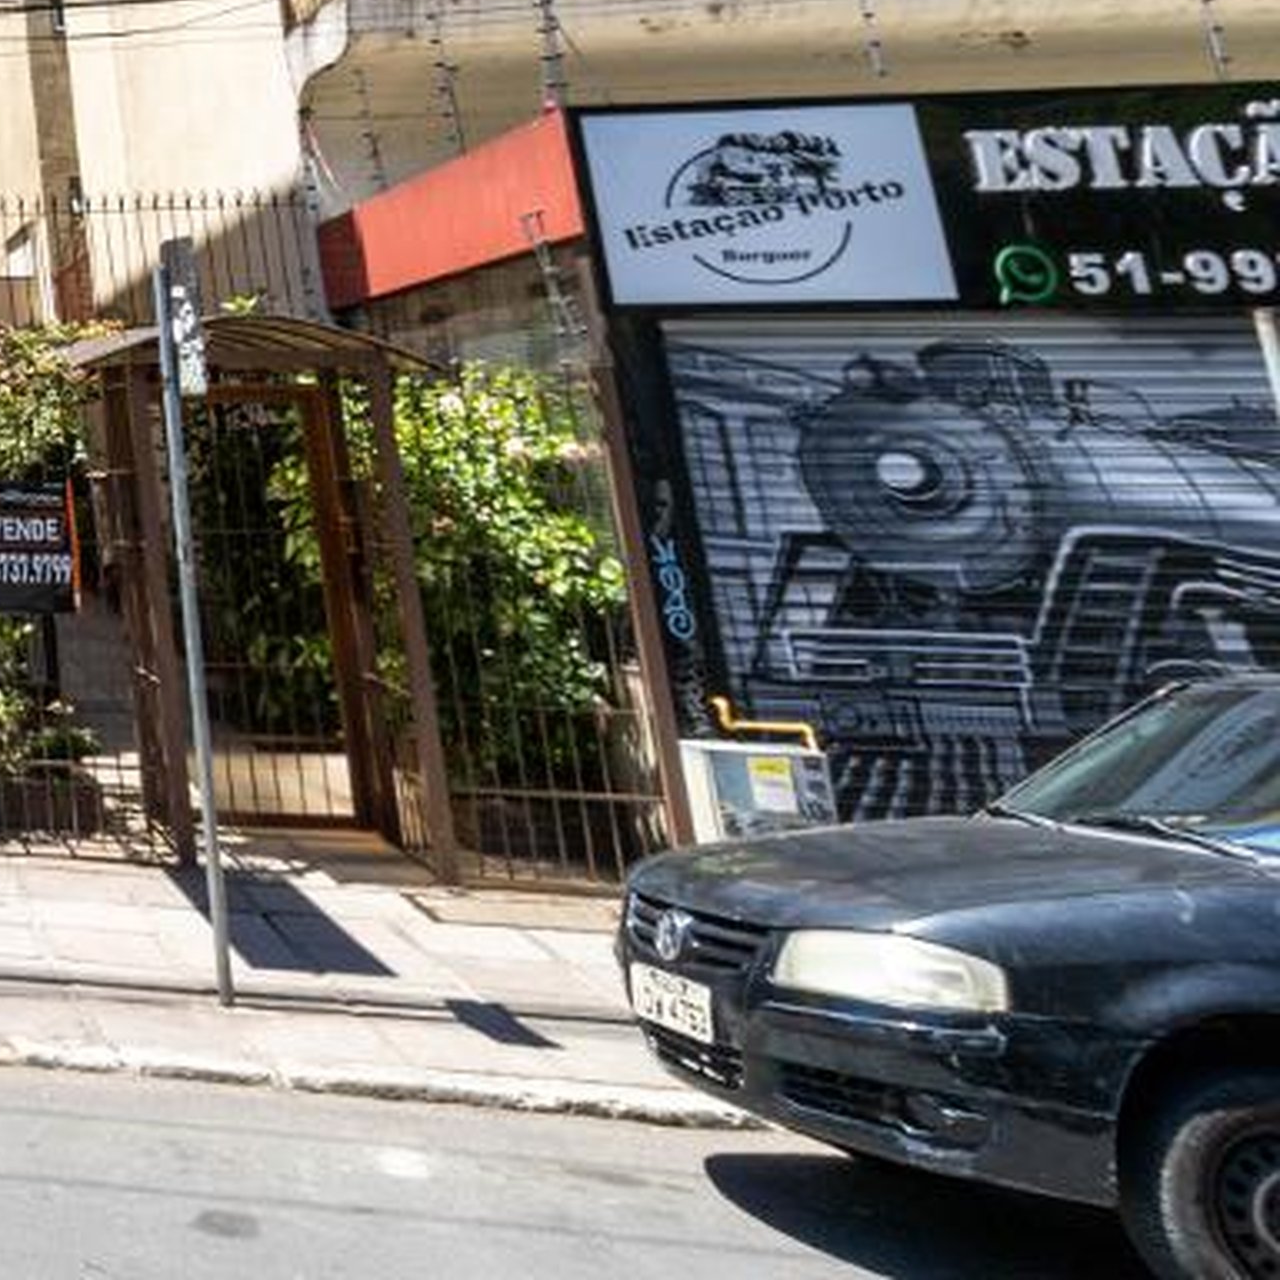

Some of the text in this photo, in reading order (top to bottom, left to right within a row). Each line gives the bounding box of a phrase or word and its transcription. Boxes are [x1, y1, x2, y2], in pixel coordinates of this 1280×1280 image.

[623, 179, 906, 250] Estação Porto
[1068, 249, 1280, 295] 51-99
